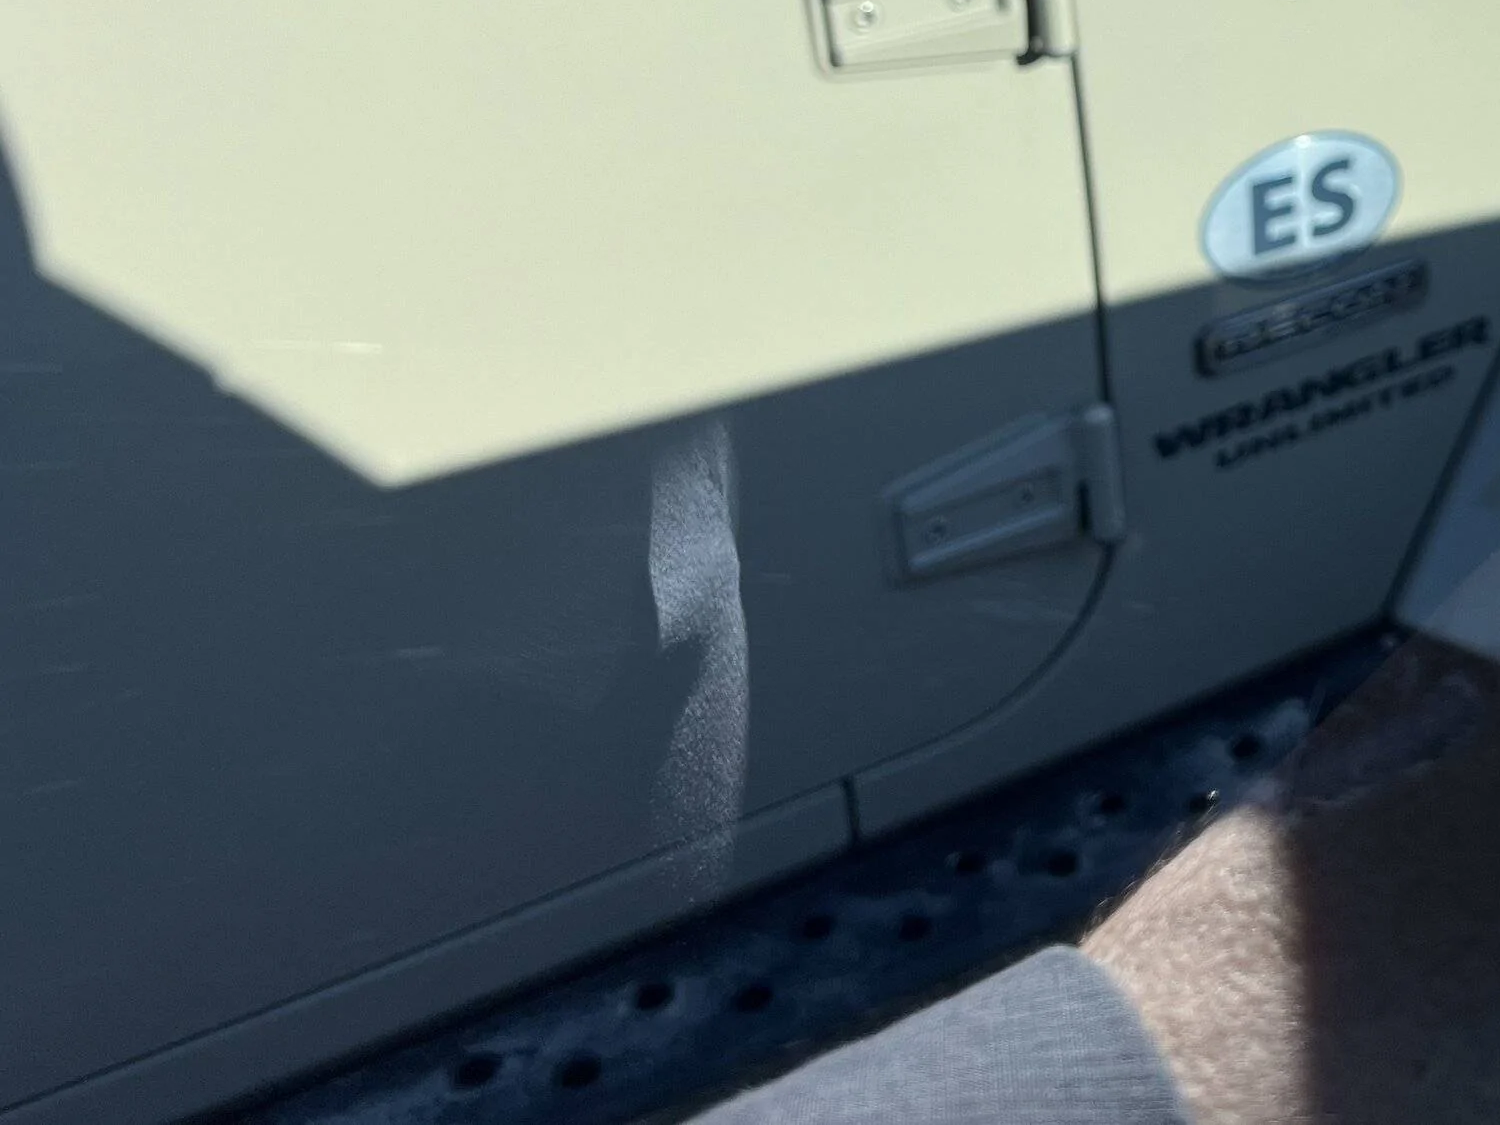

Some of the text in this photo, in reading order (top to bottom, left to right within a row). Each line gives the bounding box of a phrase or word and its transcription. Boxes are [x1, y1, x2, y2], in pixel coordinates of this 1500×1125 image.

[1251, 158, 1356, 257] ES
[1154, 315, 1491, 457] WRANGLER
[1214, 365, 1456, 468] UNLIMITED
